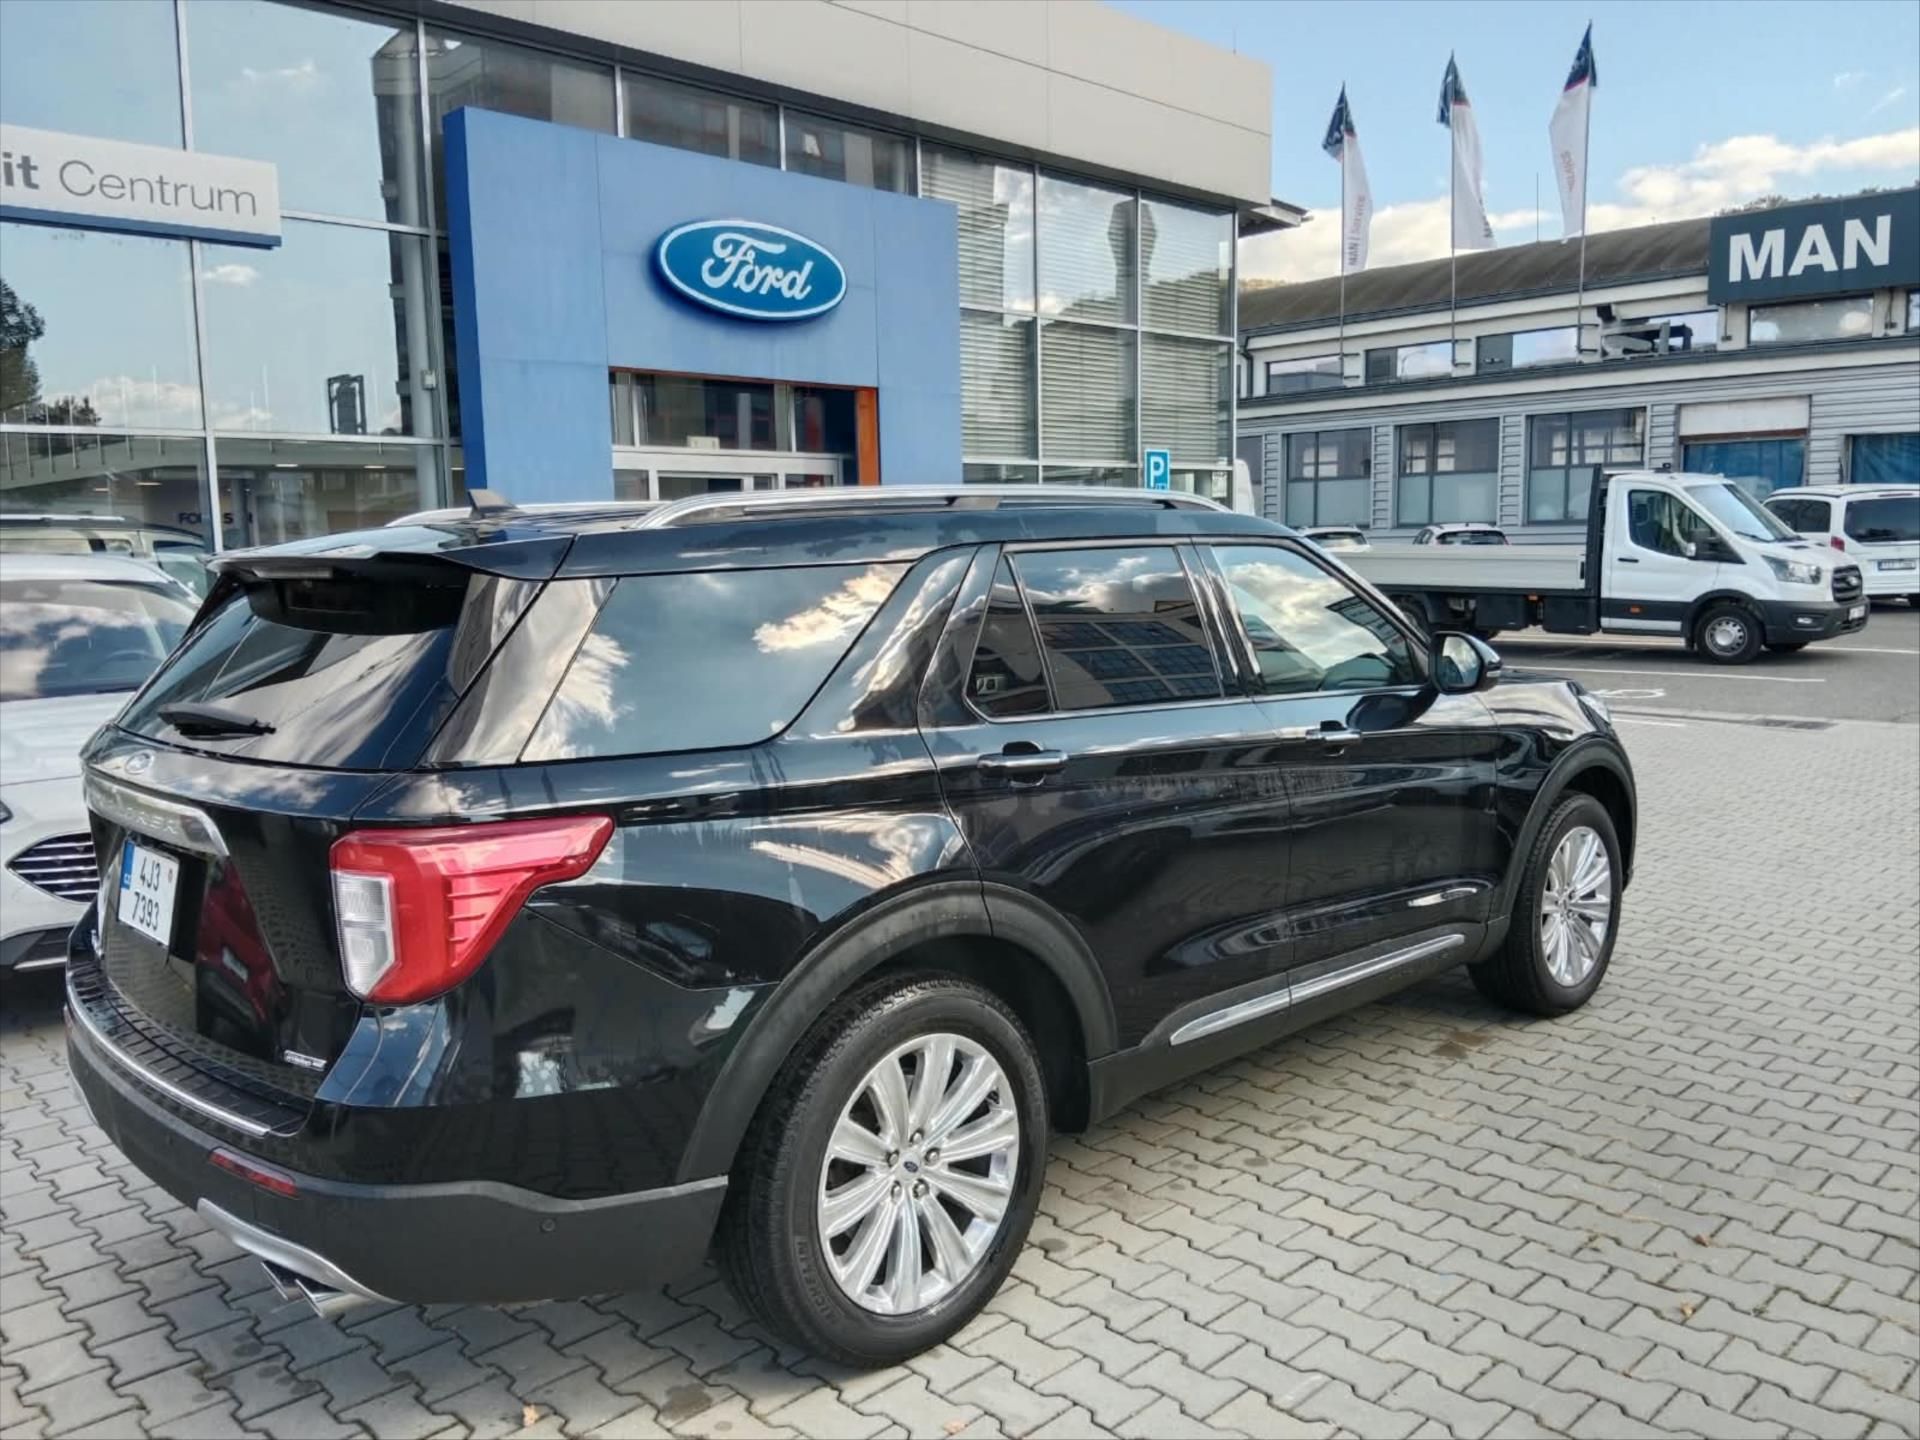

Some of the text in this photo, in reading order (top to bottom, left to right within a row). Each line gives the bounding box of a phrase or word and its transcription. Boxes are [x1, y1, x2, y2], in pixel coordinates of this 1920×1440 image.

[59, 160, 257, 216] Centrum
[701, 232, 814, 300] Ford
[1729, 214, 1892, 283] MAN
[1150, 456, 1164, 488] P
[139, 856, 160, 892] 4J3
[132, 891, 160, 932] 7393
